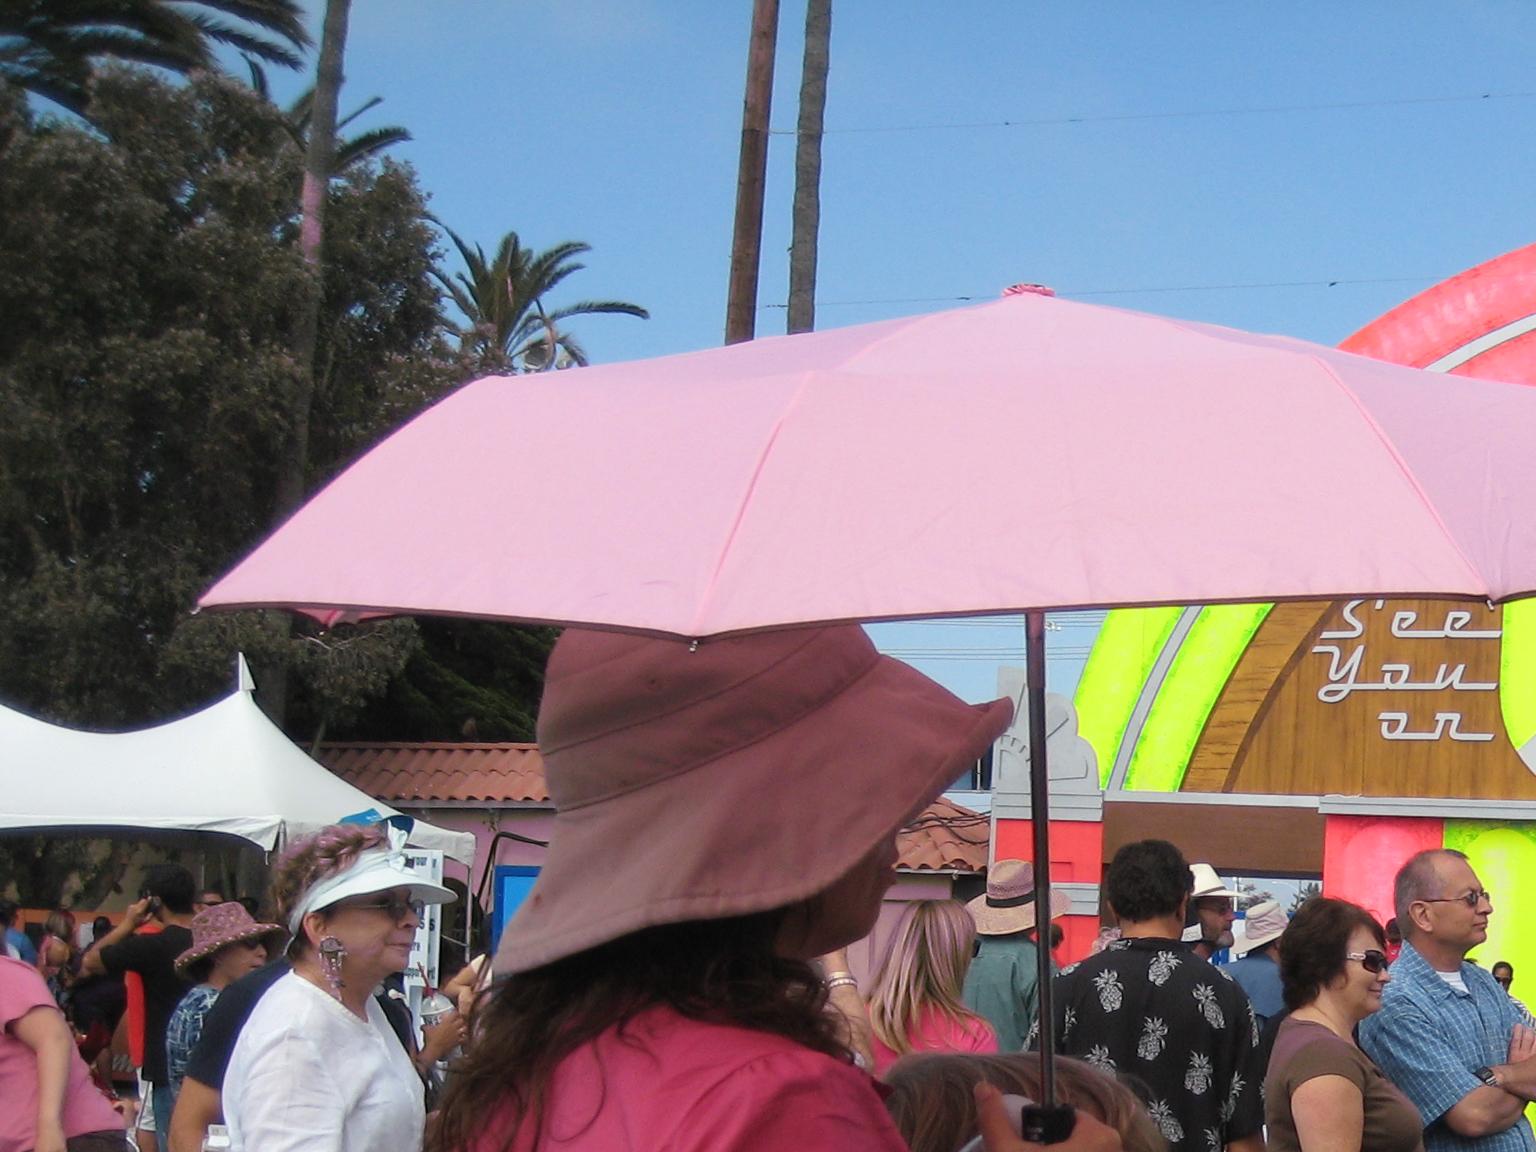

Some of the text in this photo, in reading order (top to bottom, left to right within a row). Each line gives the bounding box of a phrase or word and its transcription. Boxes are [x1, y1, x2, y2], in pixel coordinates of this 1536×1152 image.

[1319, 599, 1502, 639] See
[1312, 645, 1499, 703] You
[1377, 712, 1496, 741] on
